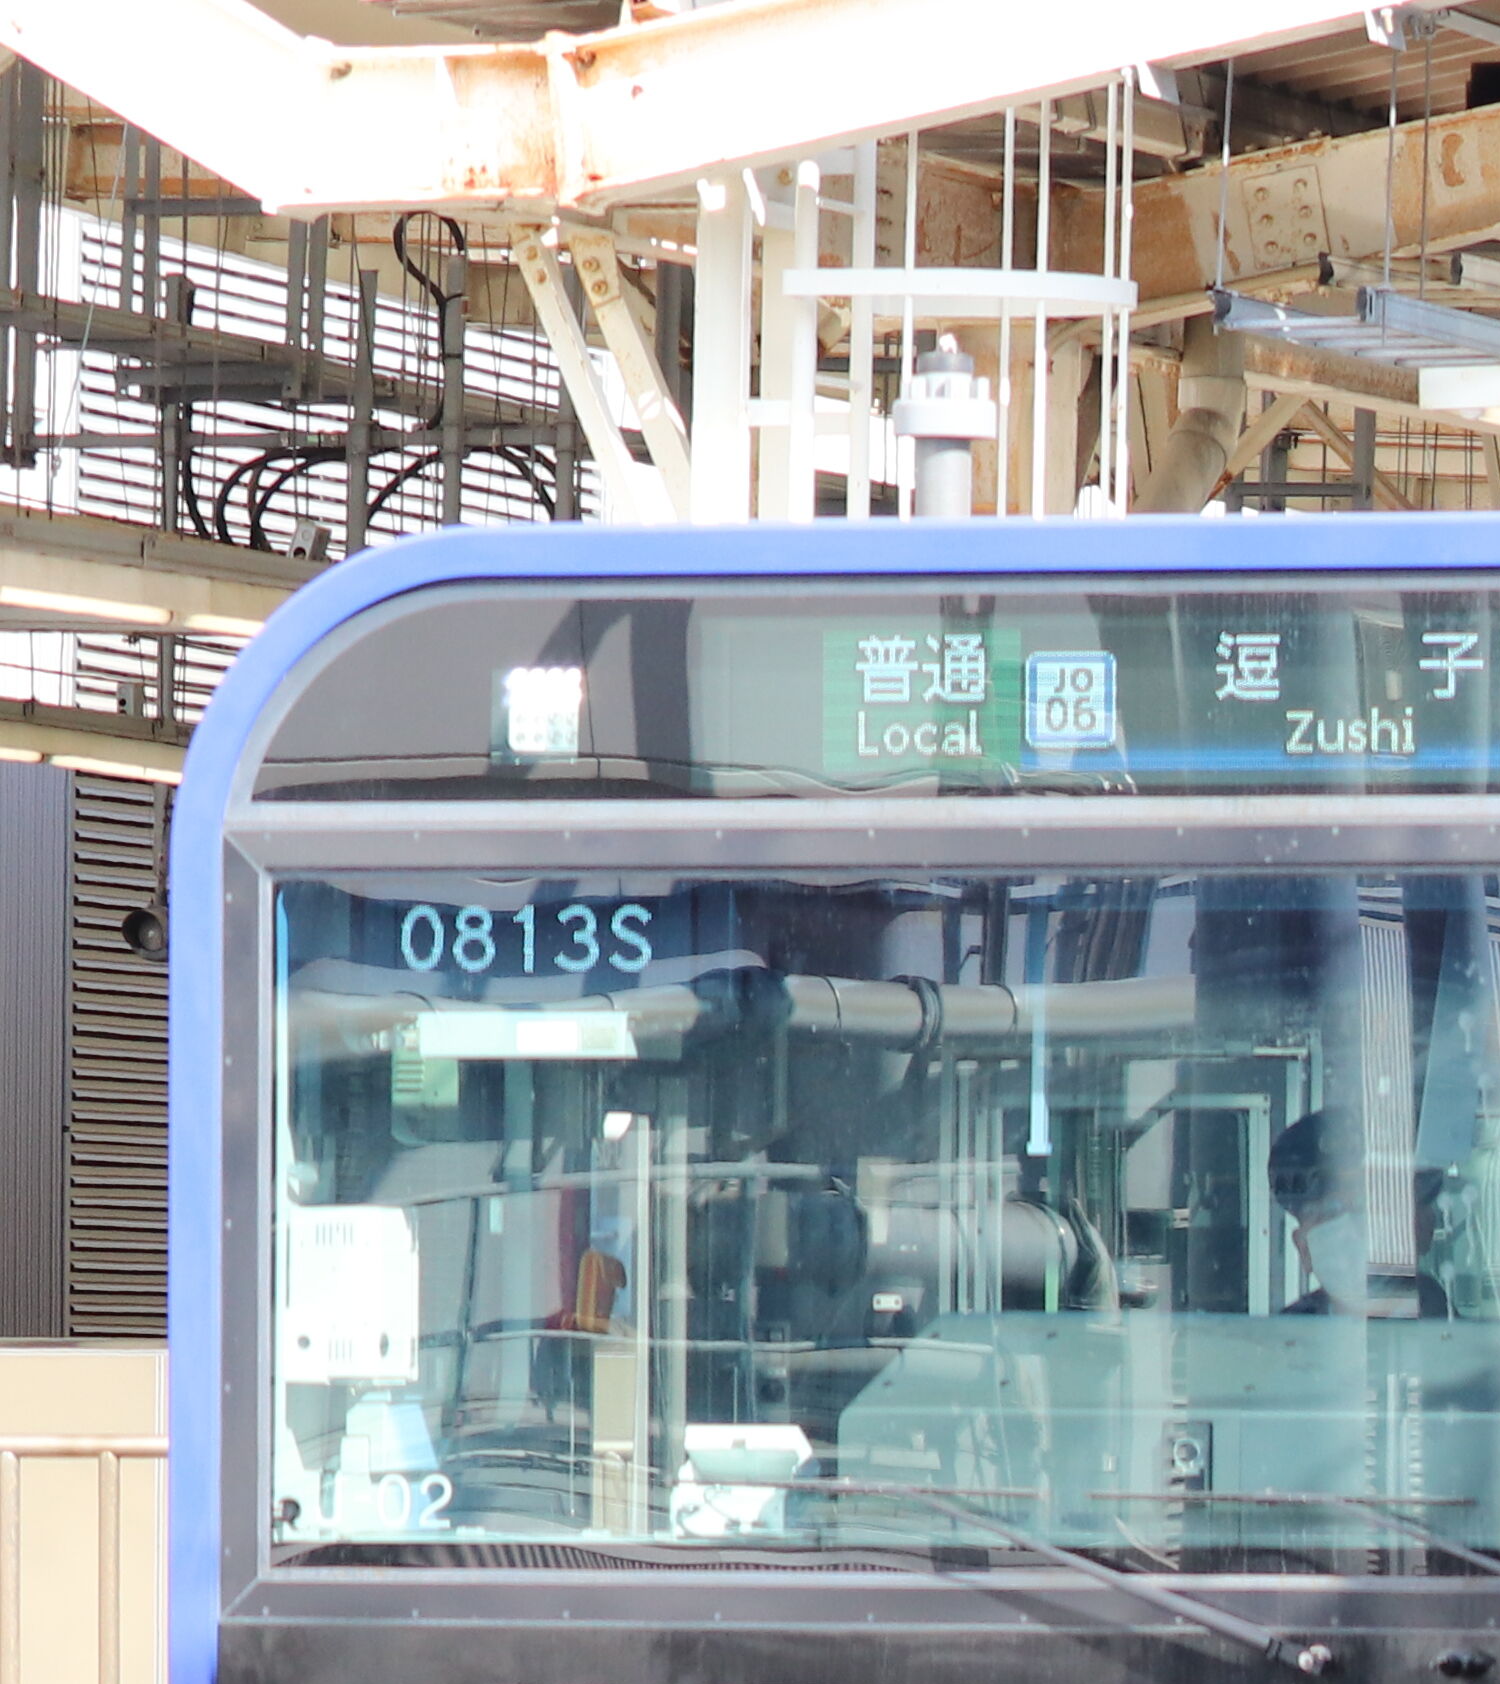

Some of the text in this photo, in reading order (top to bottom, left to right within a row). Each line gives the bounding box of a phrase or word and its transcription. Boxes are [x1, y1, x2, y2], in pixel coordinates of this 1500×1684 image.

[856, 633, 985, 702] 普通
[1053, 667, 1094, 694] JO
[1215, 631, 1484, 699] 逗子
[857, 709, 983, 755] Local
[1045, 696, 1097, 732] 06
[1285, 705, 1416, 754] Zushi
[400, 903, 653, 974] 0813S
[315, 1471, 452, 1528] J-02
